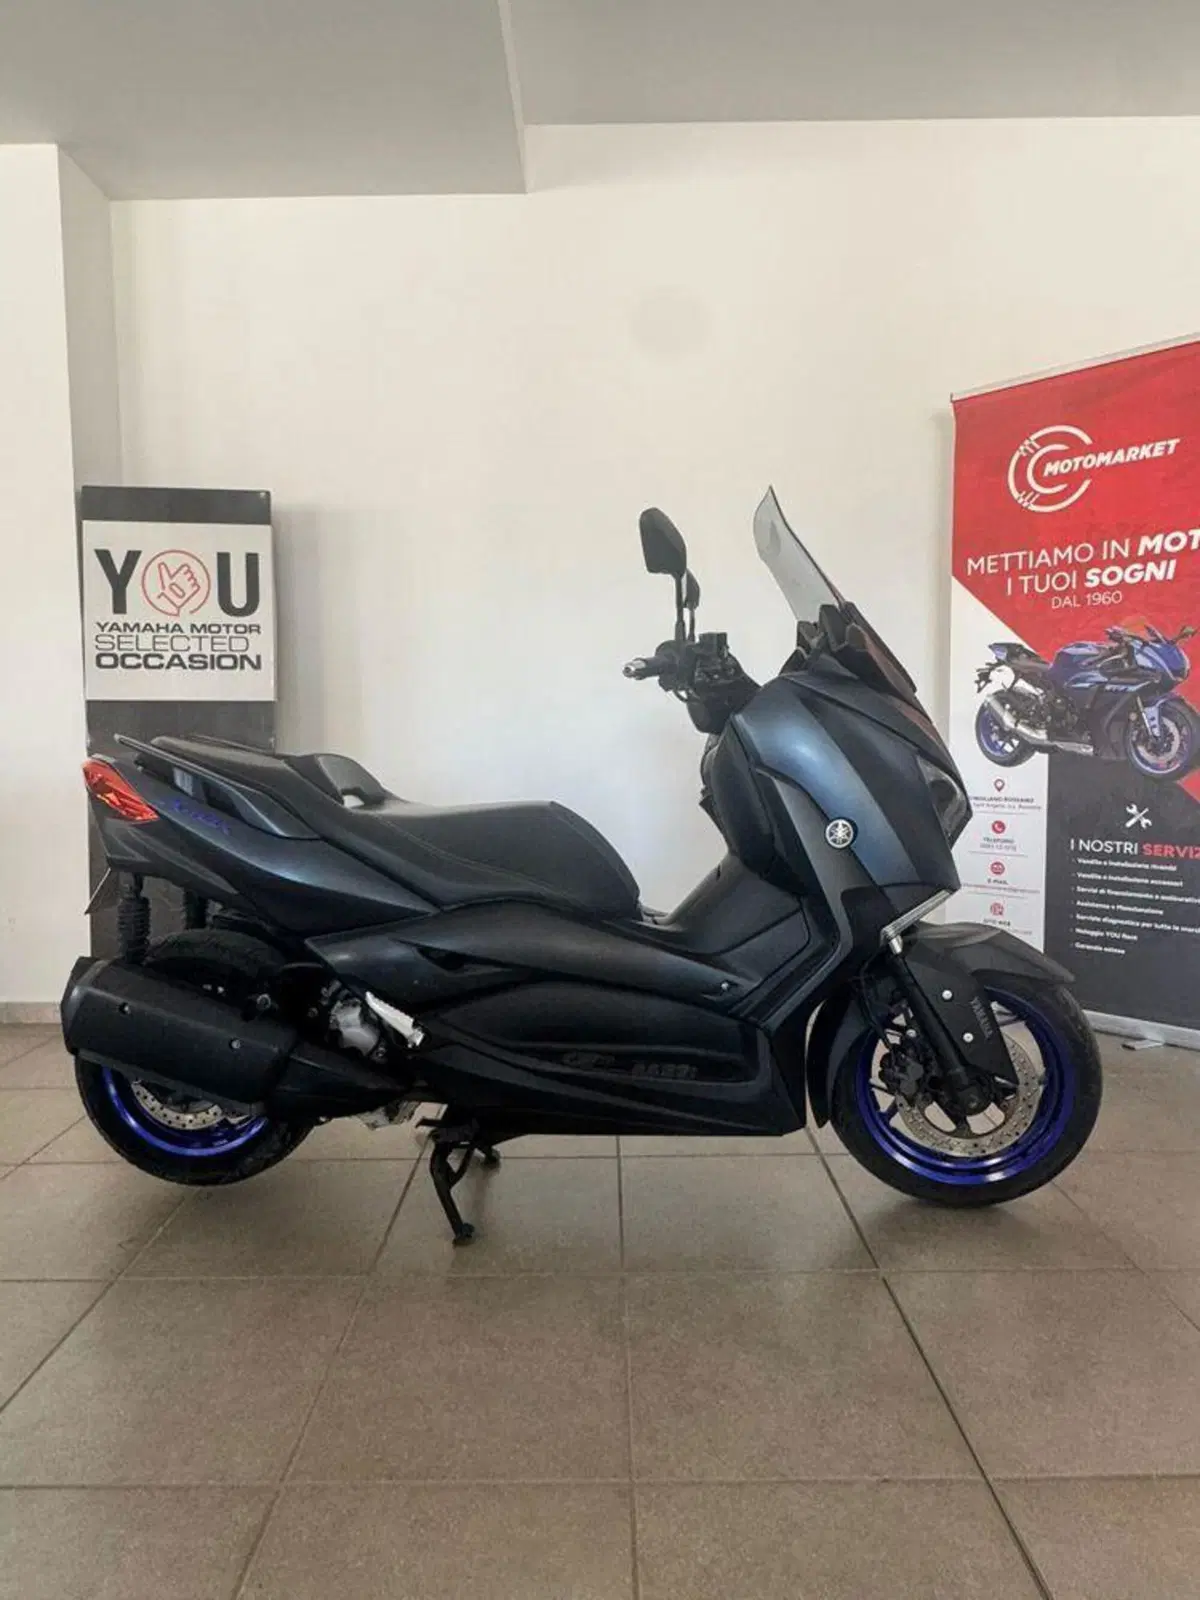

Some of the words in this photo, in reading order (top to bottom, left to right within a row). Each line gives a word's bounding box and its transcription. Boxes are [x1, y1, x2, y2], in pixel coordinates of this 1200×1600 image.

[1043, 438, 1181, 477] MOTOMARKET
[967, 543, 1094, 576] METTIAMO
[1102, 538, 1130, 560] IN
[1137, 529, 1200, 557] MOT
[1007, 577, 1012, 596] I
[1019, 570, 1077, 594] TUOI
[1084, 559, 1177, 588] SOGNI
[1051, 596, 1081, 609] DAL
[1086, 590, 1123, 605] 1960
[96, 621, 184, 634] YAMAHA
[190, 623, 262, 635] MOTOR
[95, 634, 250, 652] SELECTED
[95, 652, 262, 671] OCCASION
[1070, 838, 1075, 850] I
[1078, 839, 1138, 855] NOSTRI
